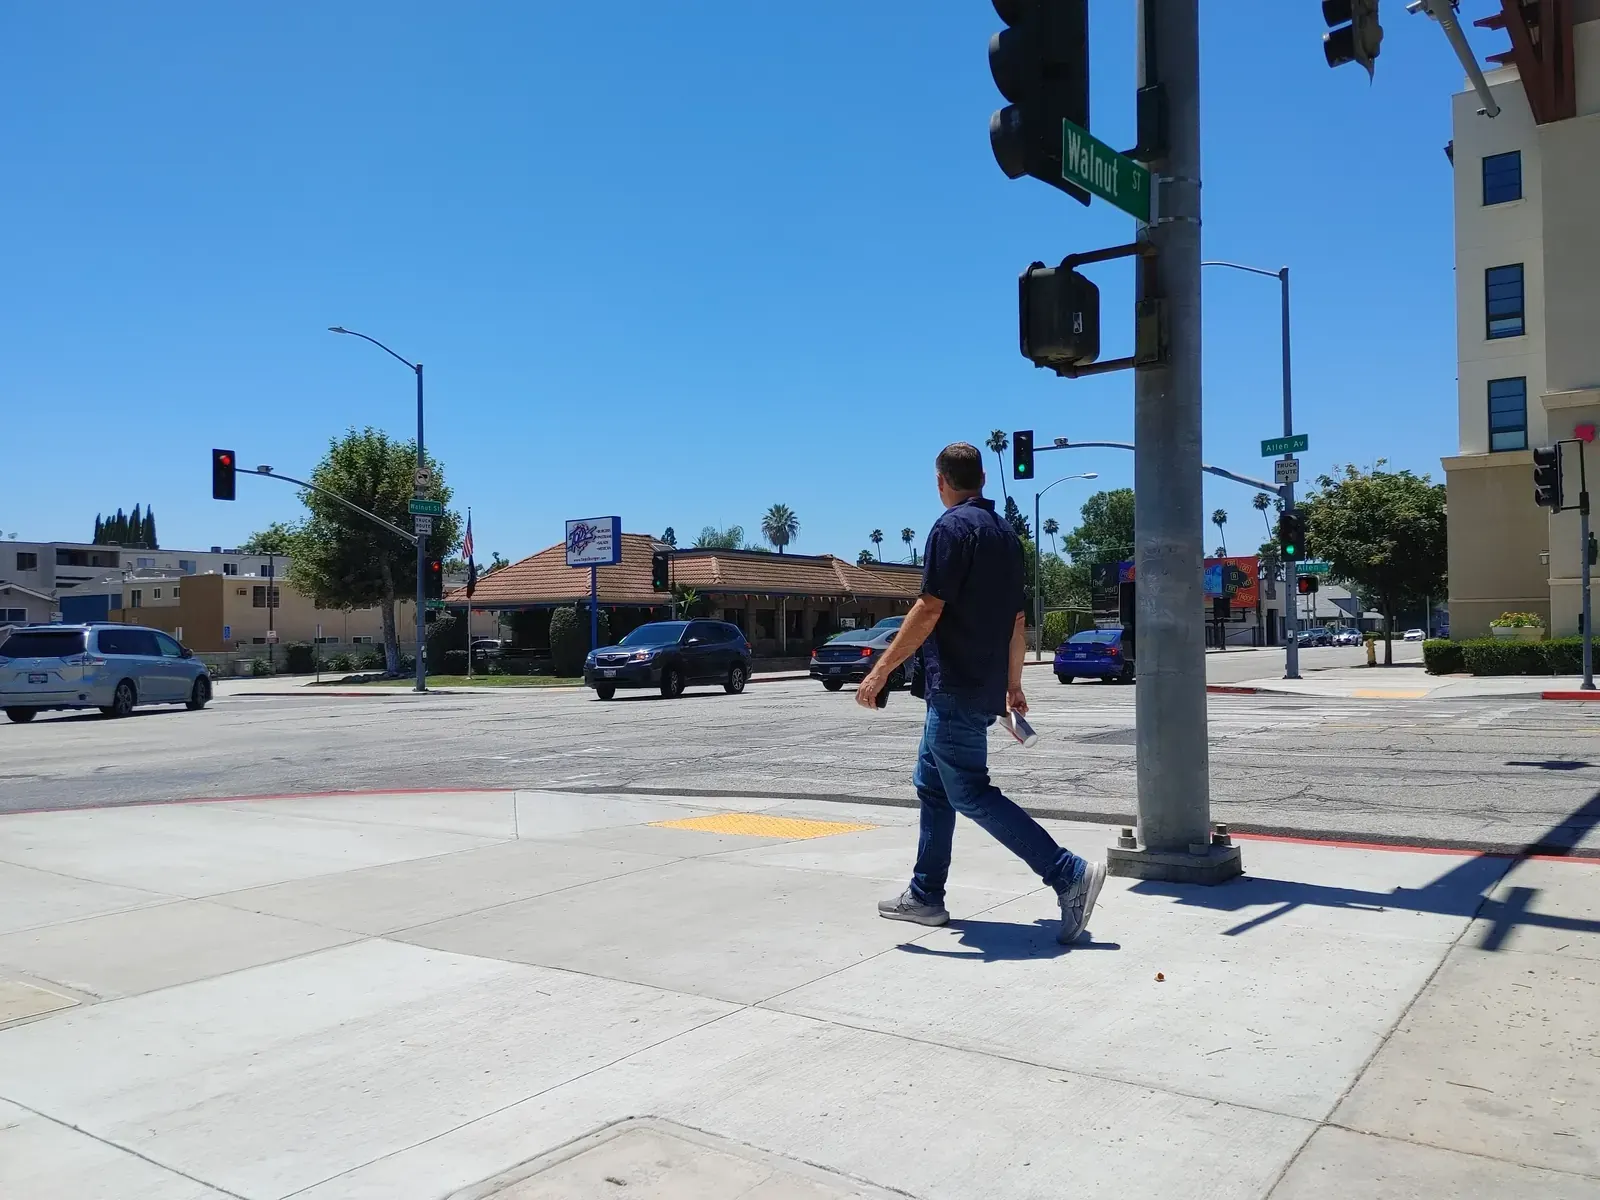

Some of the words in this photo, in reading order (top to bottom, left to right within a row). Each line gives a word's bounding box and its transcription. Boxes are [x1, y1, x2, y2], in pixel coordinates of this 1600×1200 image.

[1068, 128, 1118, 197] Walnut
[1132, 170, 1141, 192] ST
[1266, 443, 1289, 451] Allen
[1293, 440, 1304, 448] Av
[411, 503, 430, 511] Walnut
